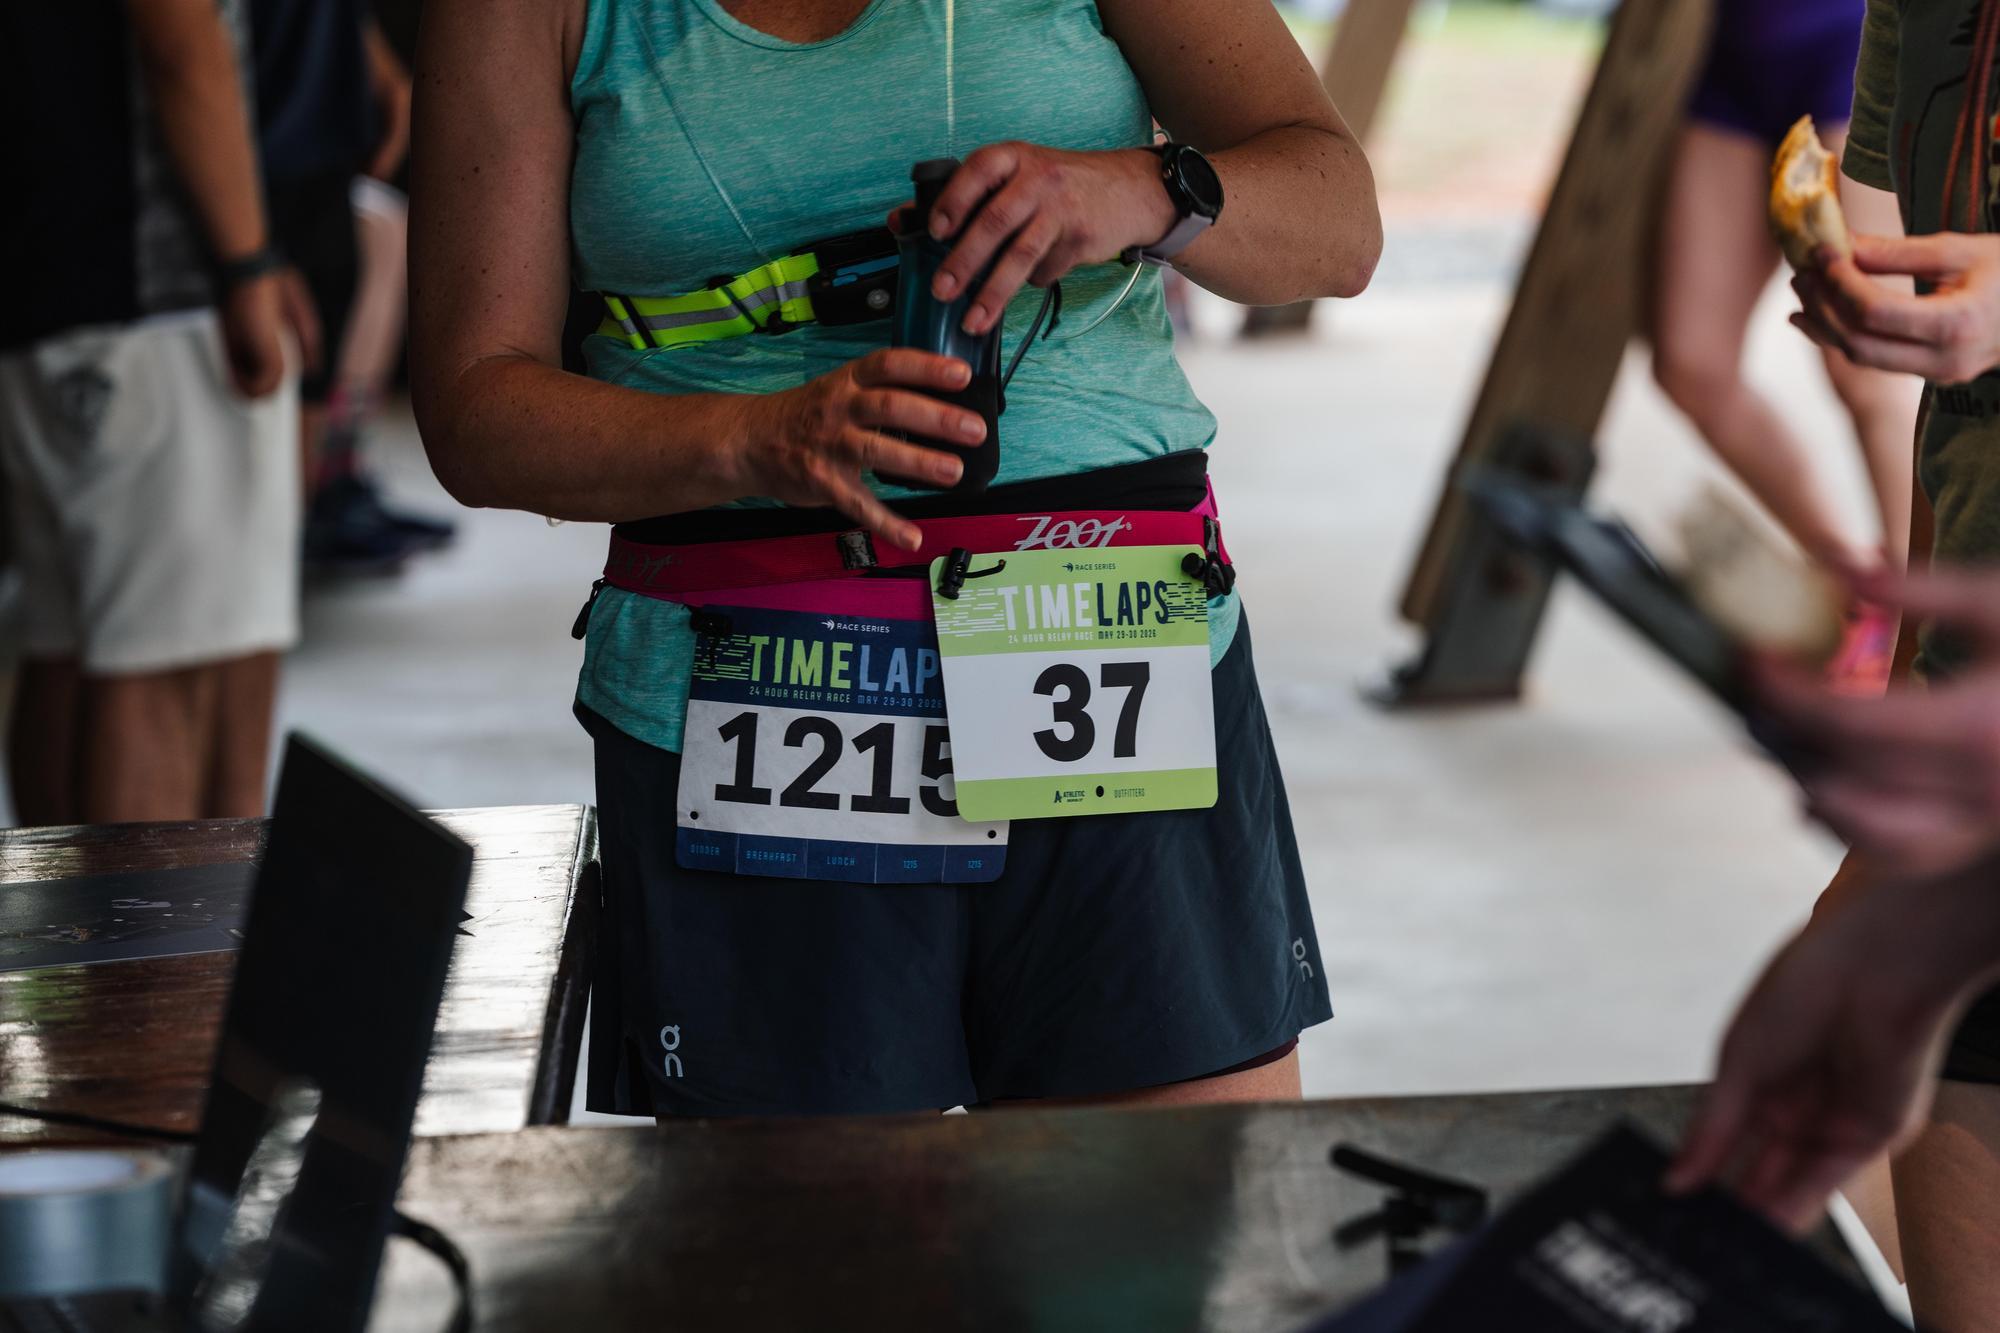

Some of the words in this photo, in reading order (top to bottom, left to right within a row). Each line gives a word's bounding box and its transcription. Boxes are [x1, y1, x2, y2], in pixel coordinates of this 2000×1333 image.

[1075, 563, 1093, 571] RACE
[1094, 562, 1116, 571] SERIES
[836, 622, 859, 632] RACE
[861, 624, 890, 633] SERIES
[1008, 635, 1018, 644] 24
[1022, 633, 1044, 643] HOUR
[1048, 631, 1071, 642] RELAY
[1075, 631, 1093, 641] RACE
[1098, 630, 1113, 640] MAY
[1140, 629, 1156, 638] 2026
[749, 635, 939, 694] TIMELAP
[749, 686, 760, 695] 24
[764, 687, 788, 698] HOUR
[793, 690, 822, 701] RELAY
[826, 692, 850, 703] RACE
[858, 694, 878, 704] MAY
[883, 696, 913, 707] 29-30
[1033, 661, 1150, 762] 37
[714, 711, 960, 817] 1215
[1114, 788, 1145, 798] OUTFITTERS
[826, 855, 855, 866] LUNCH
[903, 860, 918, 869] 1215
